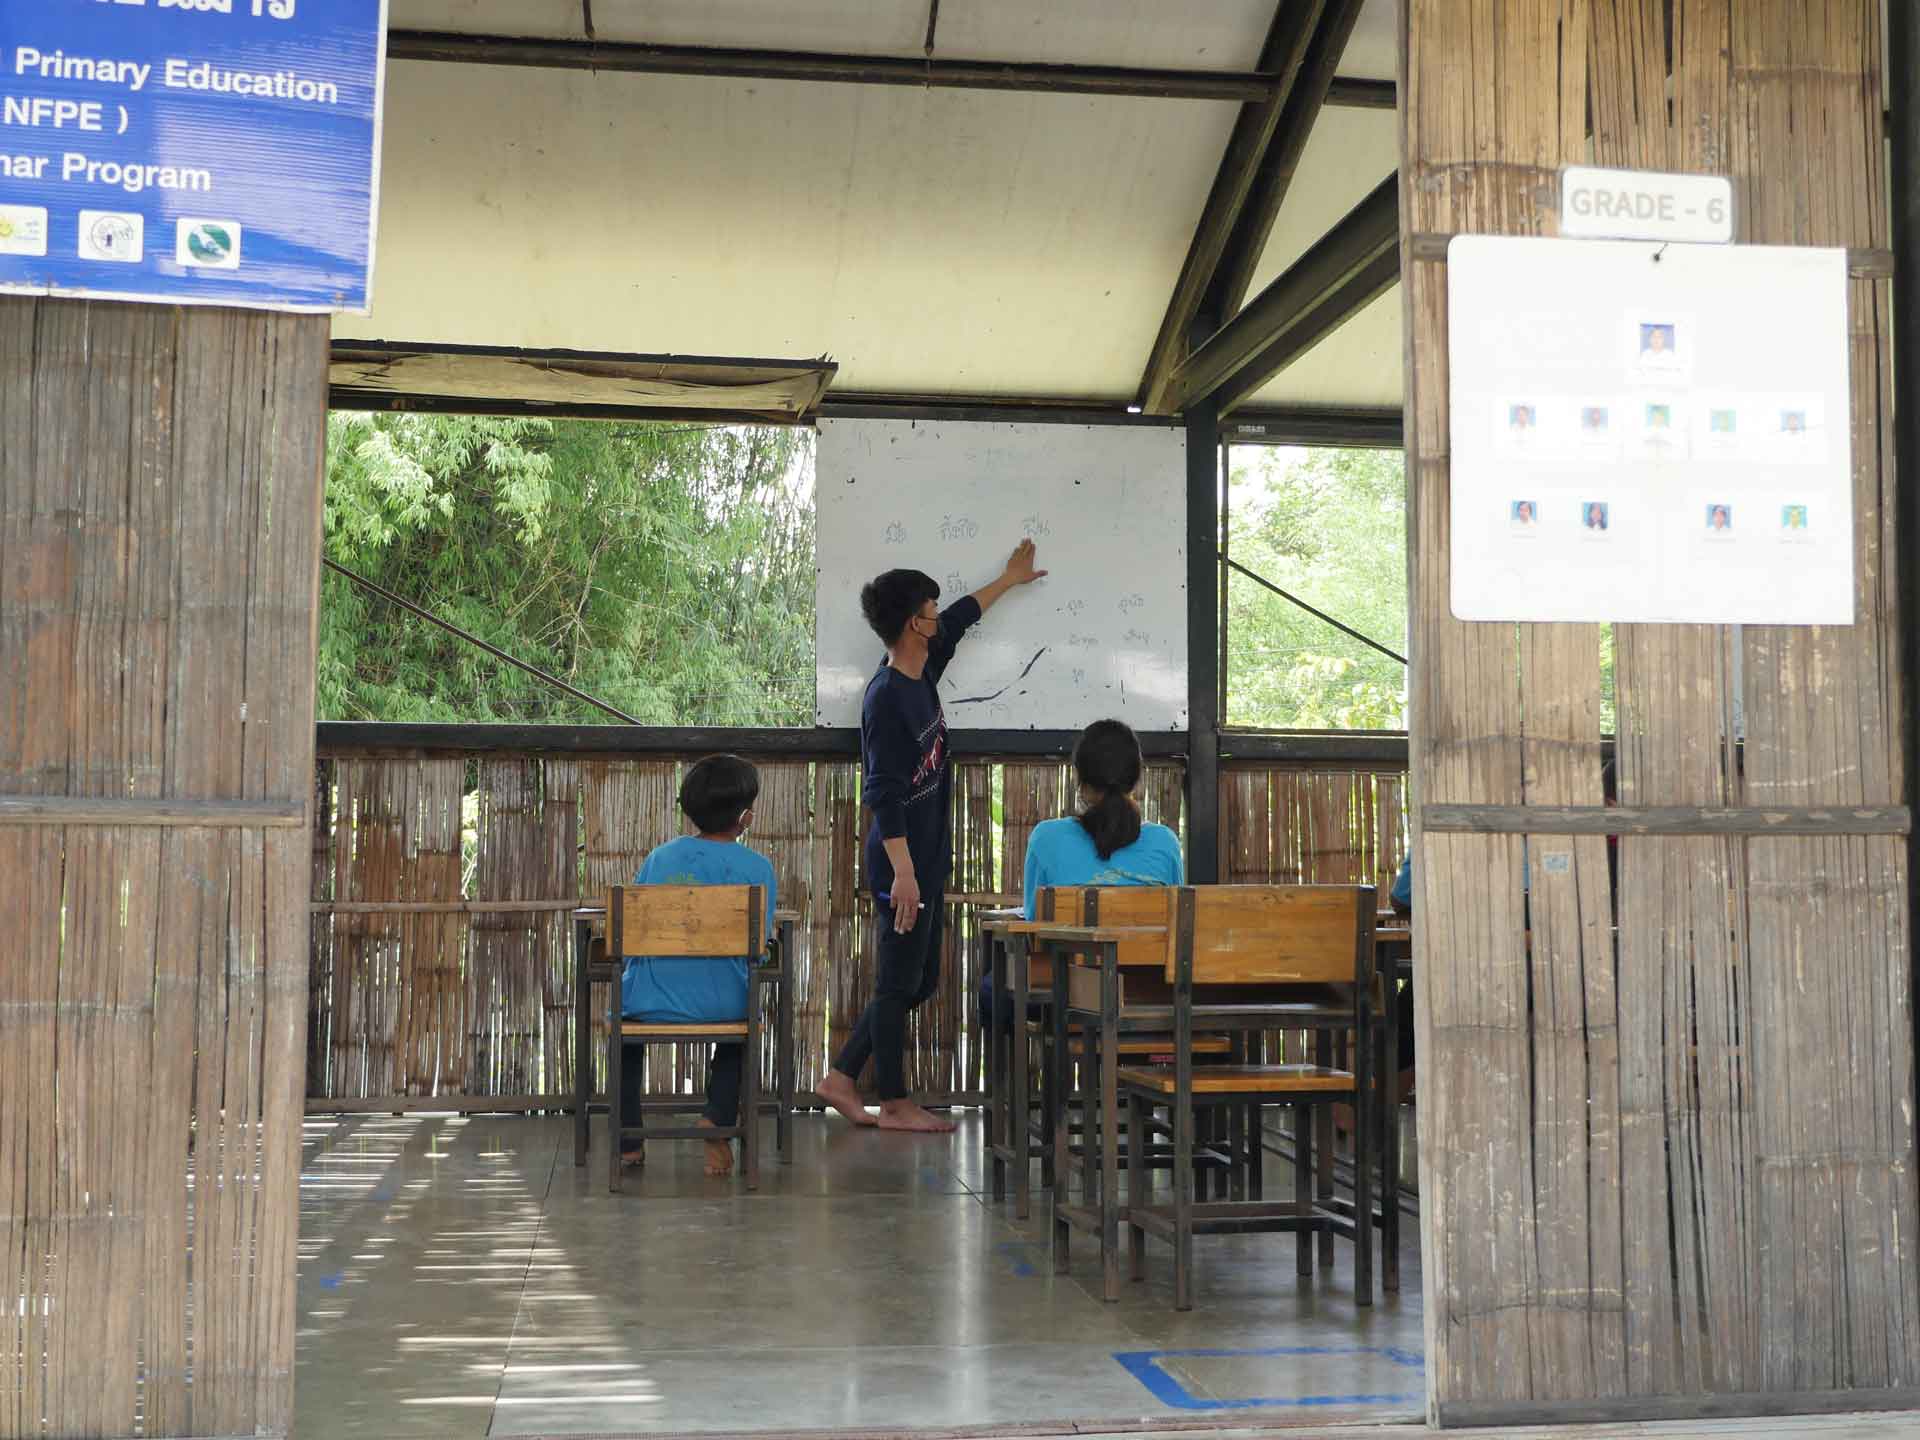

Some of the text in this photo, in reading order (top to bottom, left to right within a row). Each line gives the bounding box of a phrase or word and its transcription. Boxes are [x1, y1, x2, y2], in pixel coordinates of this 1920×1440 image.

[15, 47, 338, 104] Primary Education
[3, 96, 103, 131] NFPE
[62, 152, 211, 192] Program
[1570, 188, 1676, 222] GRADE
[1706, 198, 1725, 224] 6
